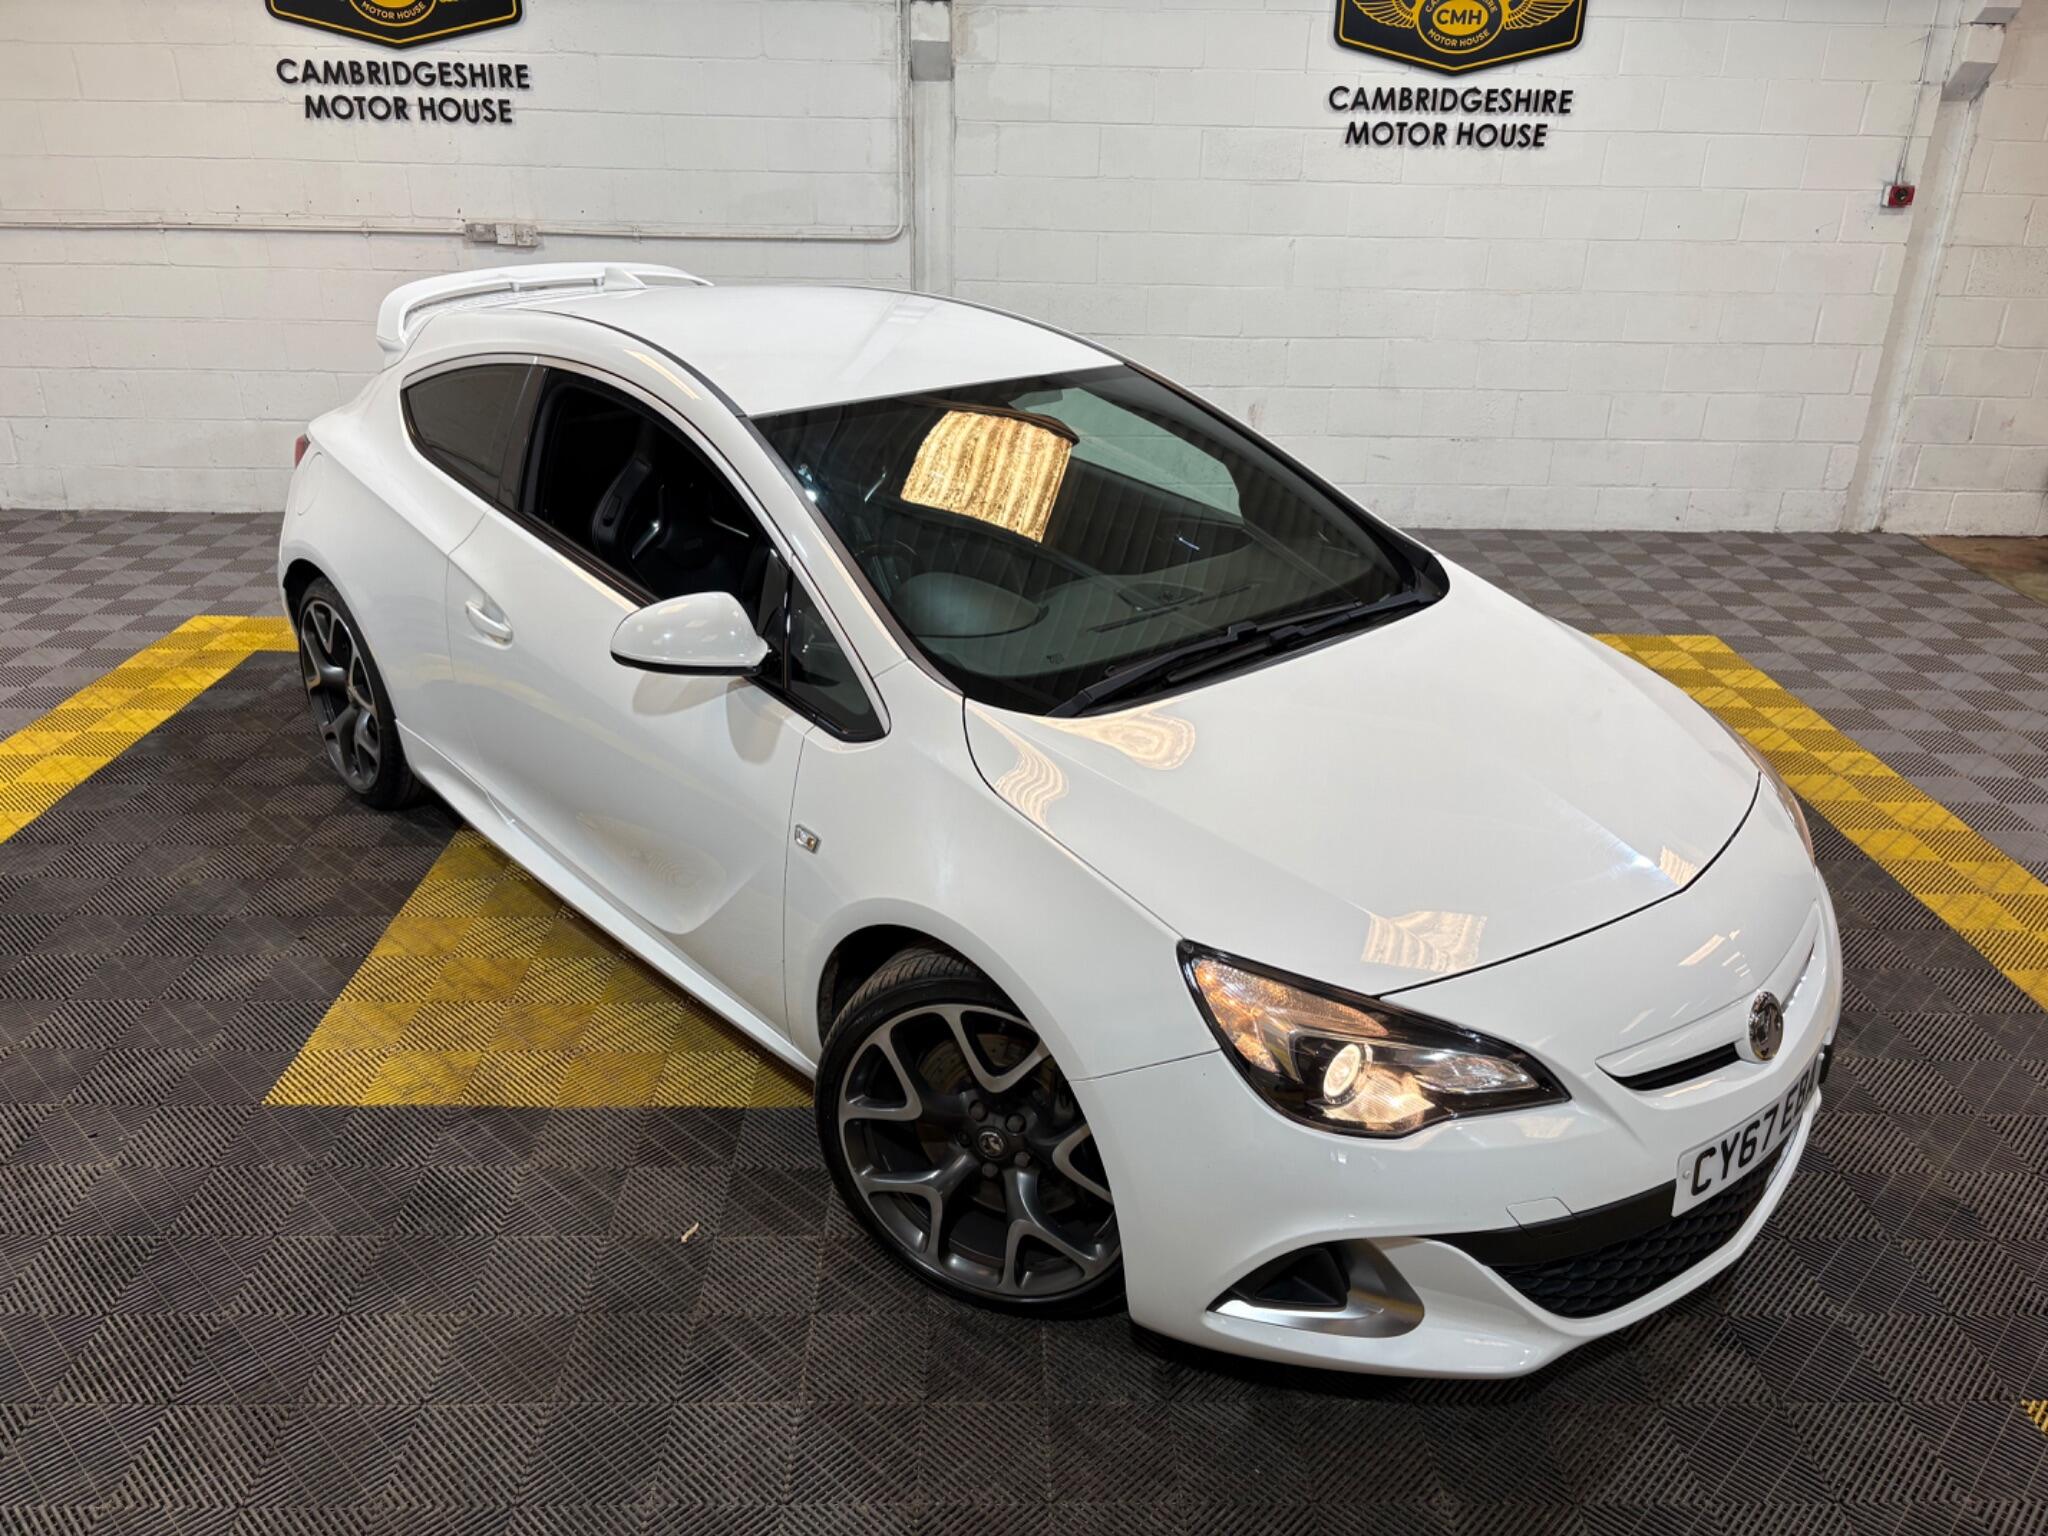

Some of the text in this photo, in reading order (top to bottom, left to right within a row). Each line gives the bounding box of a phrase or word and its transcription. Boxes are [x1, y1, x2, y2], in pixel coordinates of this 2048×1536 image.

[361, 1, 426, 19] MOTOR HOUSE
[1437, 9, 1482, 25] CMH
[1427, 28, 1490, 47] MOTOR HOUSE
[276, 58, 530, 89] CAMBRIDGESHIRE
[304, 95, 513, 124] MOTOR HOUSE
[1328, 86, 1574, 114] CAMBRIDGESHIRE
[1344, 121, 1549, 148] MOTOR HOUSE
[1690, 1103, 1780, 1197] CY67
